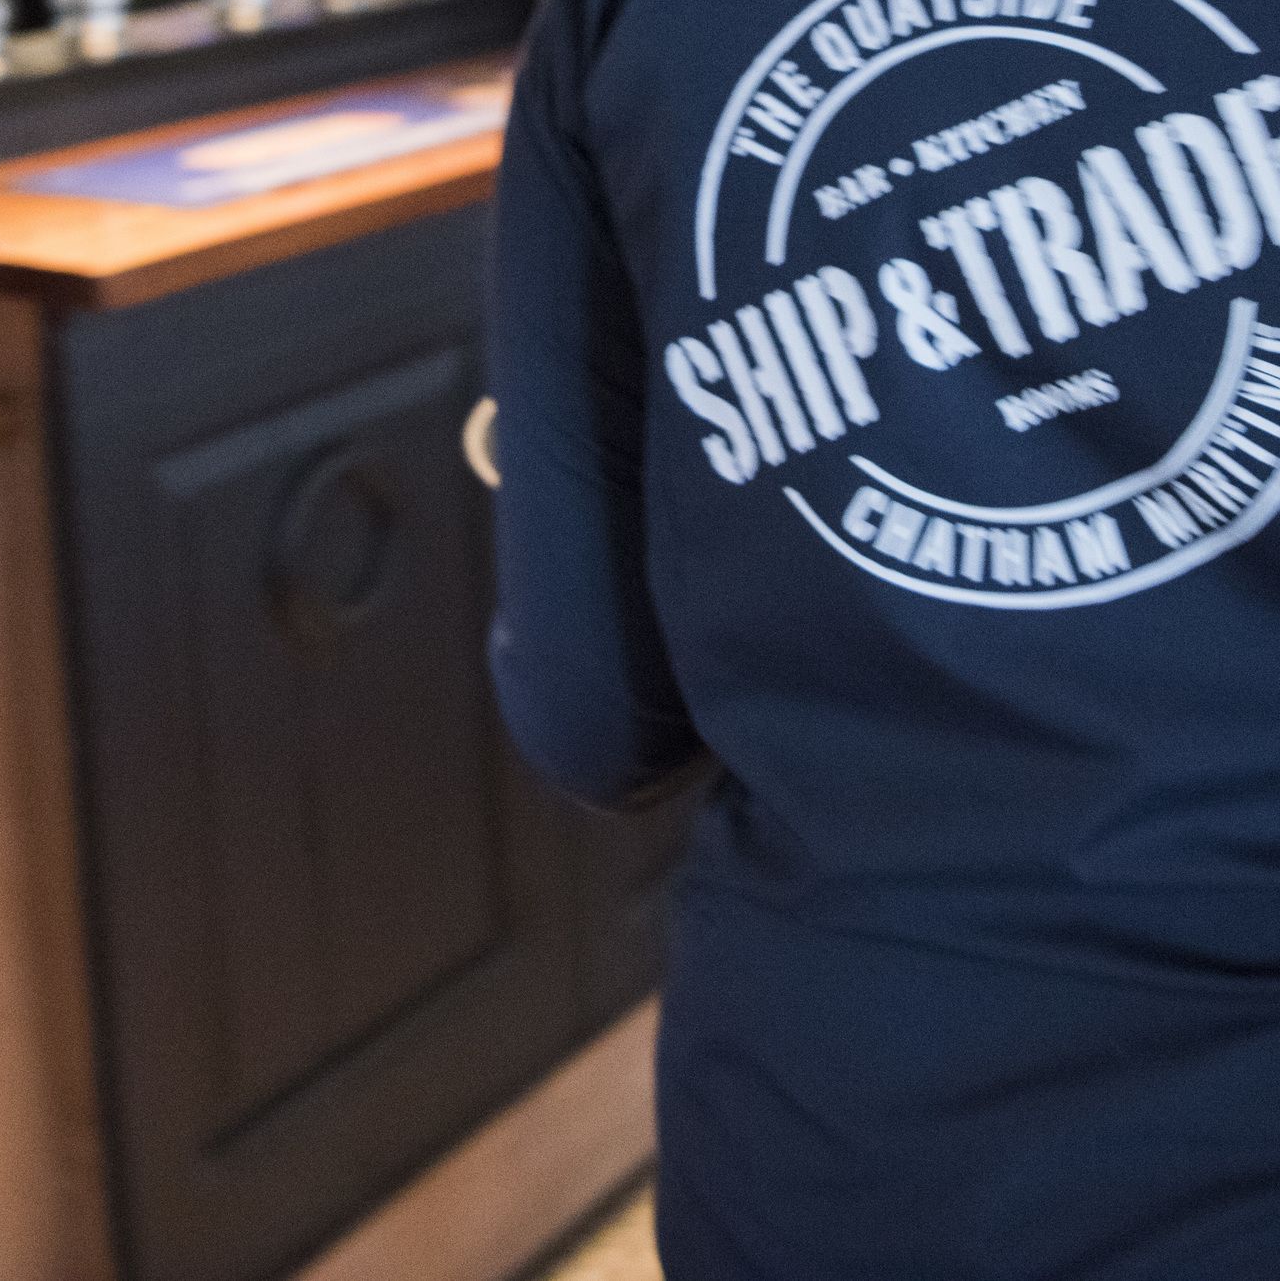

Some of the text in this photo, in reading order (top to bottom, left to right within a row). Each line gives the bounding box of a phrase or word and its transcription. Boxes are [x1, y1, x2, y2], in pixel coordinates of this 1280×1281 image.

[729, 59, 826, 166] THE
[813, 78, 1087, 220] BAR KITCHEN
[664, 265, 880, 485] SHIP
[877, 257, 982, 371] &
[841, 484, 1132, 587] CHATHAM
